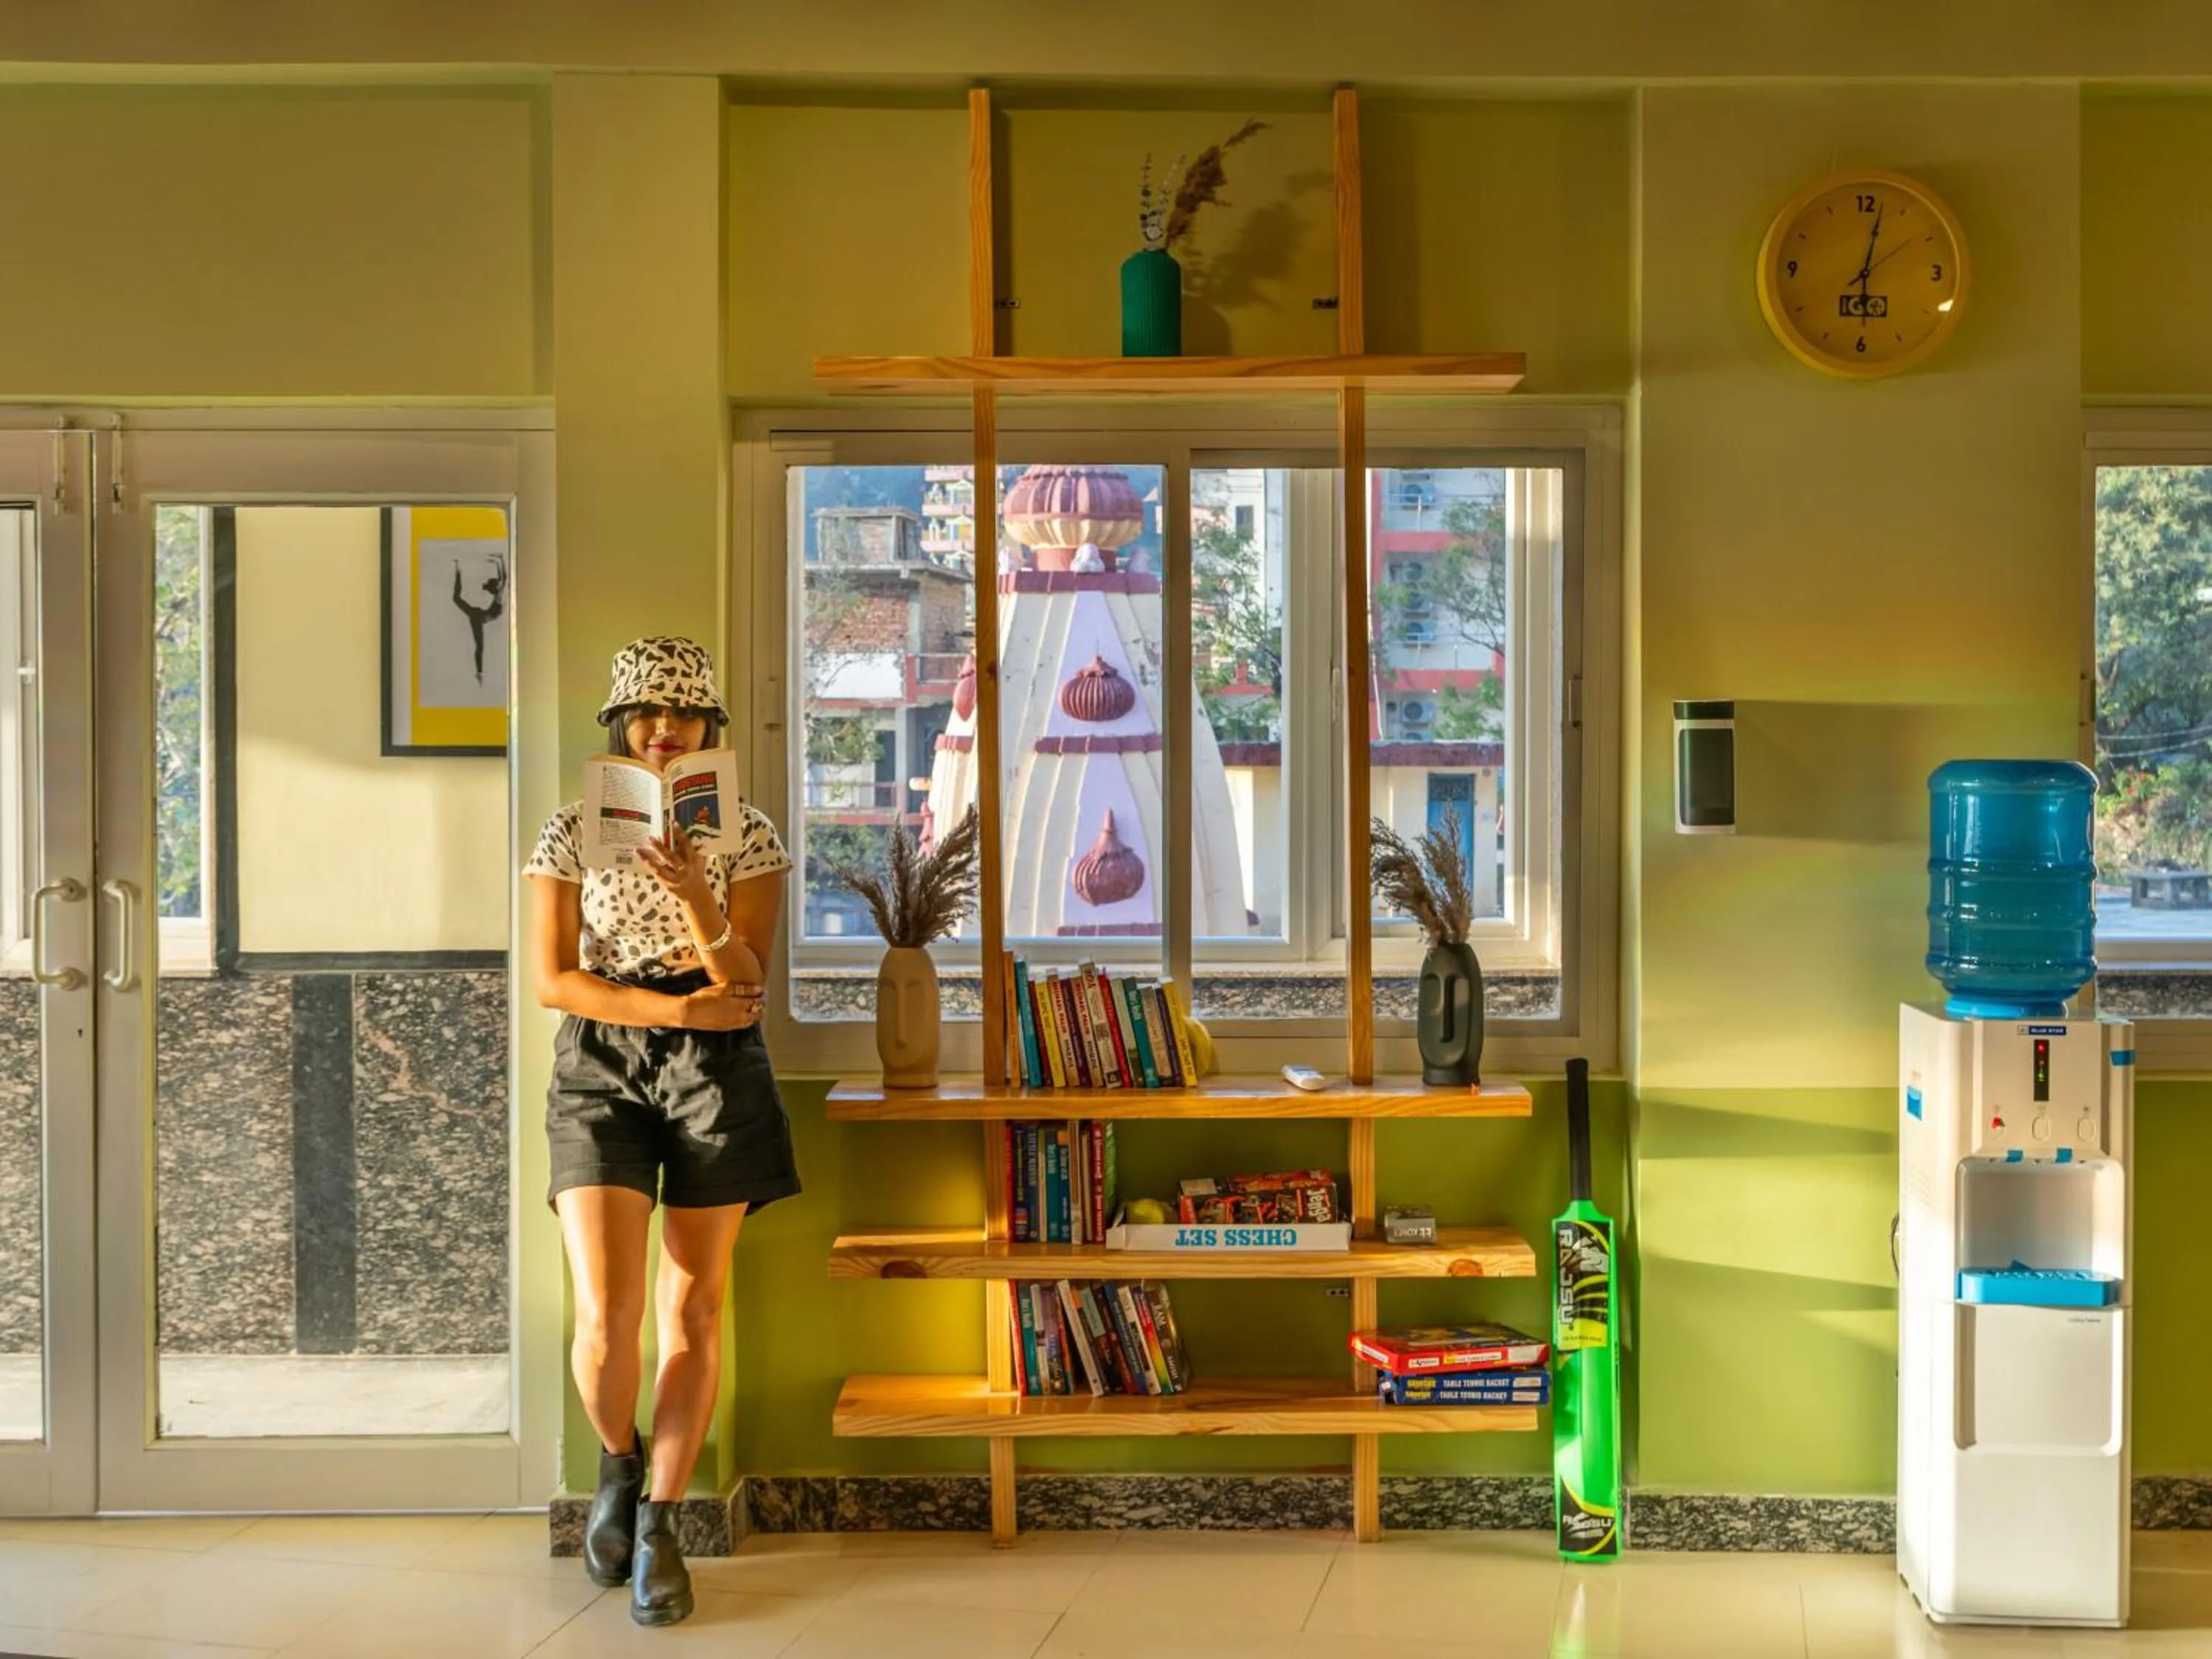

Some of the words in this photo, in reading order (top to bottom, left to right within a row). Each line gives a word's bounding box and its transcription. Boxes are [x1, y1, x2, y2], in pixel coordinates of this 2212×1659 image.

[1855, 195, 1876, 213] 12
[1787, 260, 1798, 279] 9
[1931, 265, 1943, 282] 3
[1855, 336, 1866, 352] 6
[1307, 1187, 1332, 1222] Jenga
[1175, 1229, 1218, 1247] SET
[1224, 1229, 1297, 1247] CHESS
[1464, 1379, 1484, 1387] TENNIS
